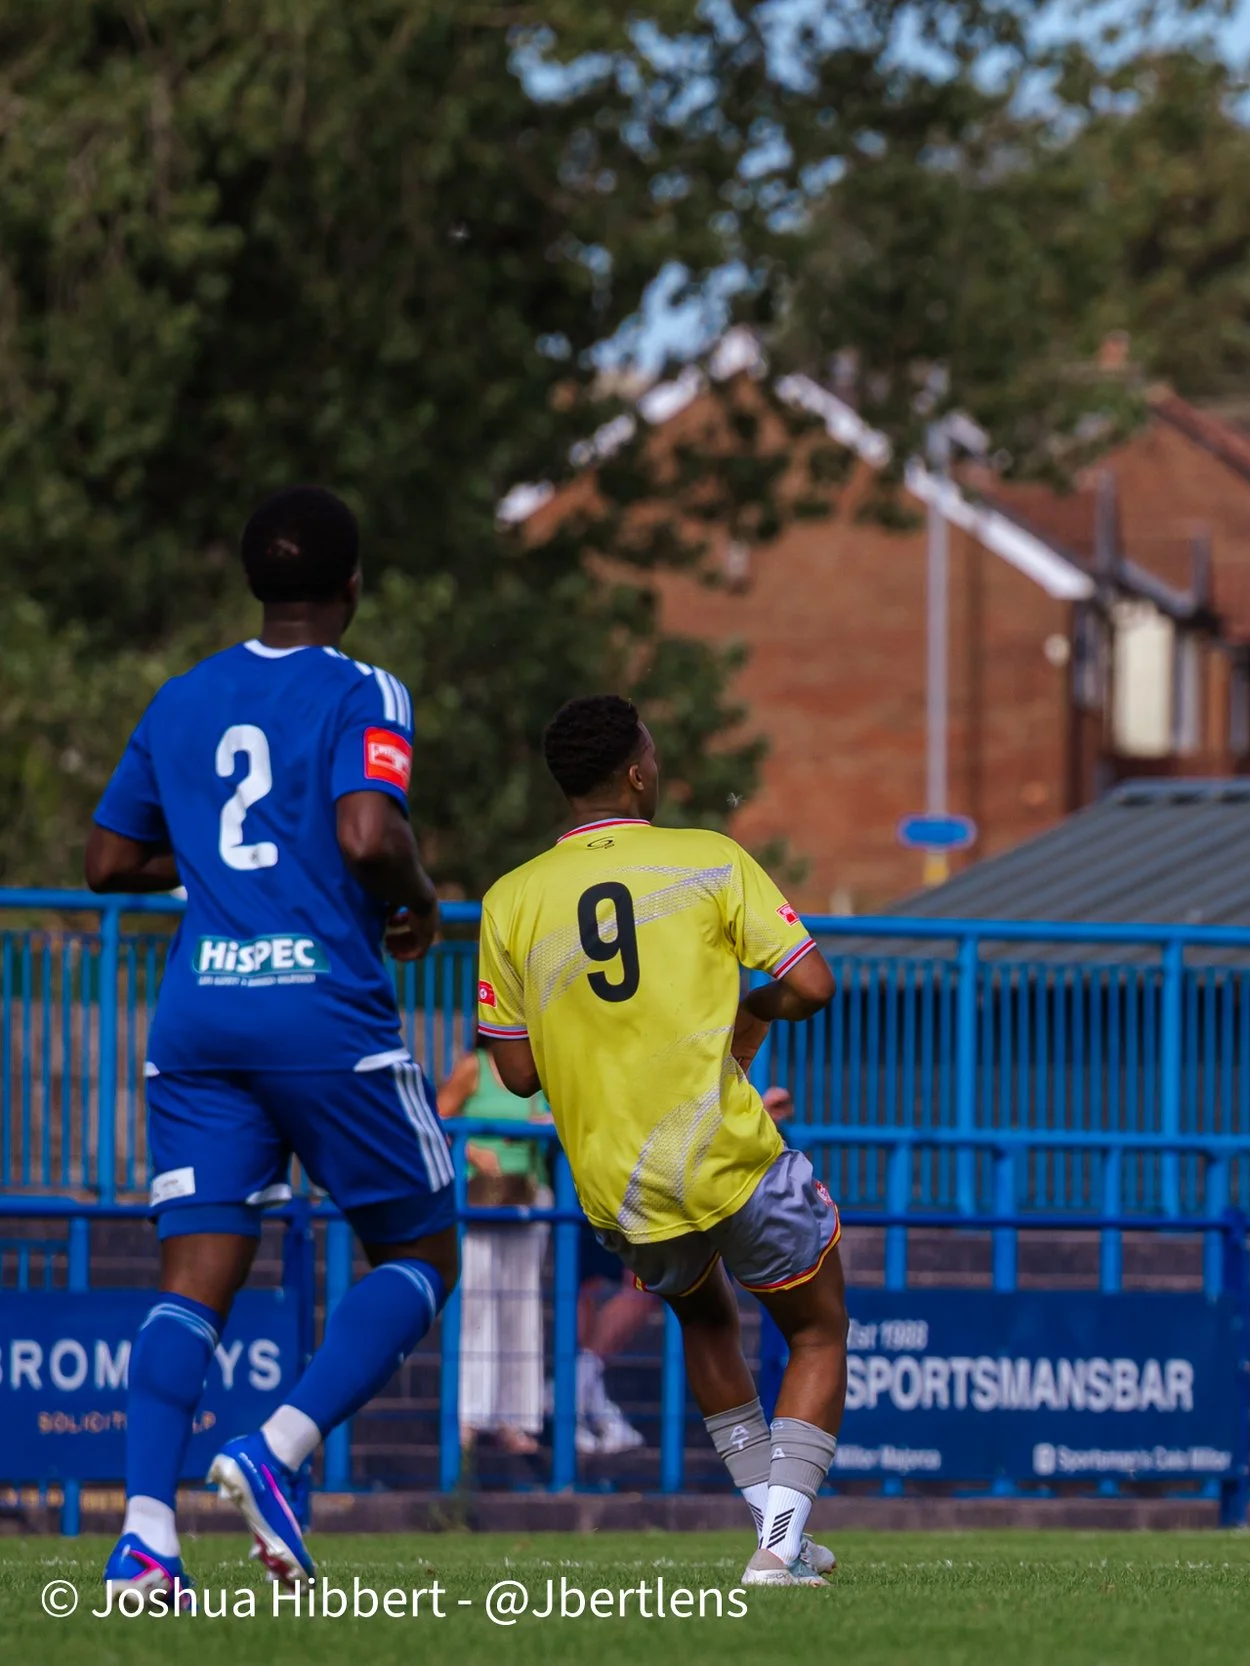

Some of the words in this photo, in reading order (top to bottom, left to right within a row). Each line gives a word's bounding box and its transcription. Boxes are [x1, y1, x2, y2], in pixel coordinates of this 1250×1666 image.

[215, 724, 278, 871] 2
[577, 882, 641, 1003] 9
[0, 1338, 283, 1392] ROMYS
[844, 1354, 1195, 1413] SPORTSMANSBAR
